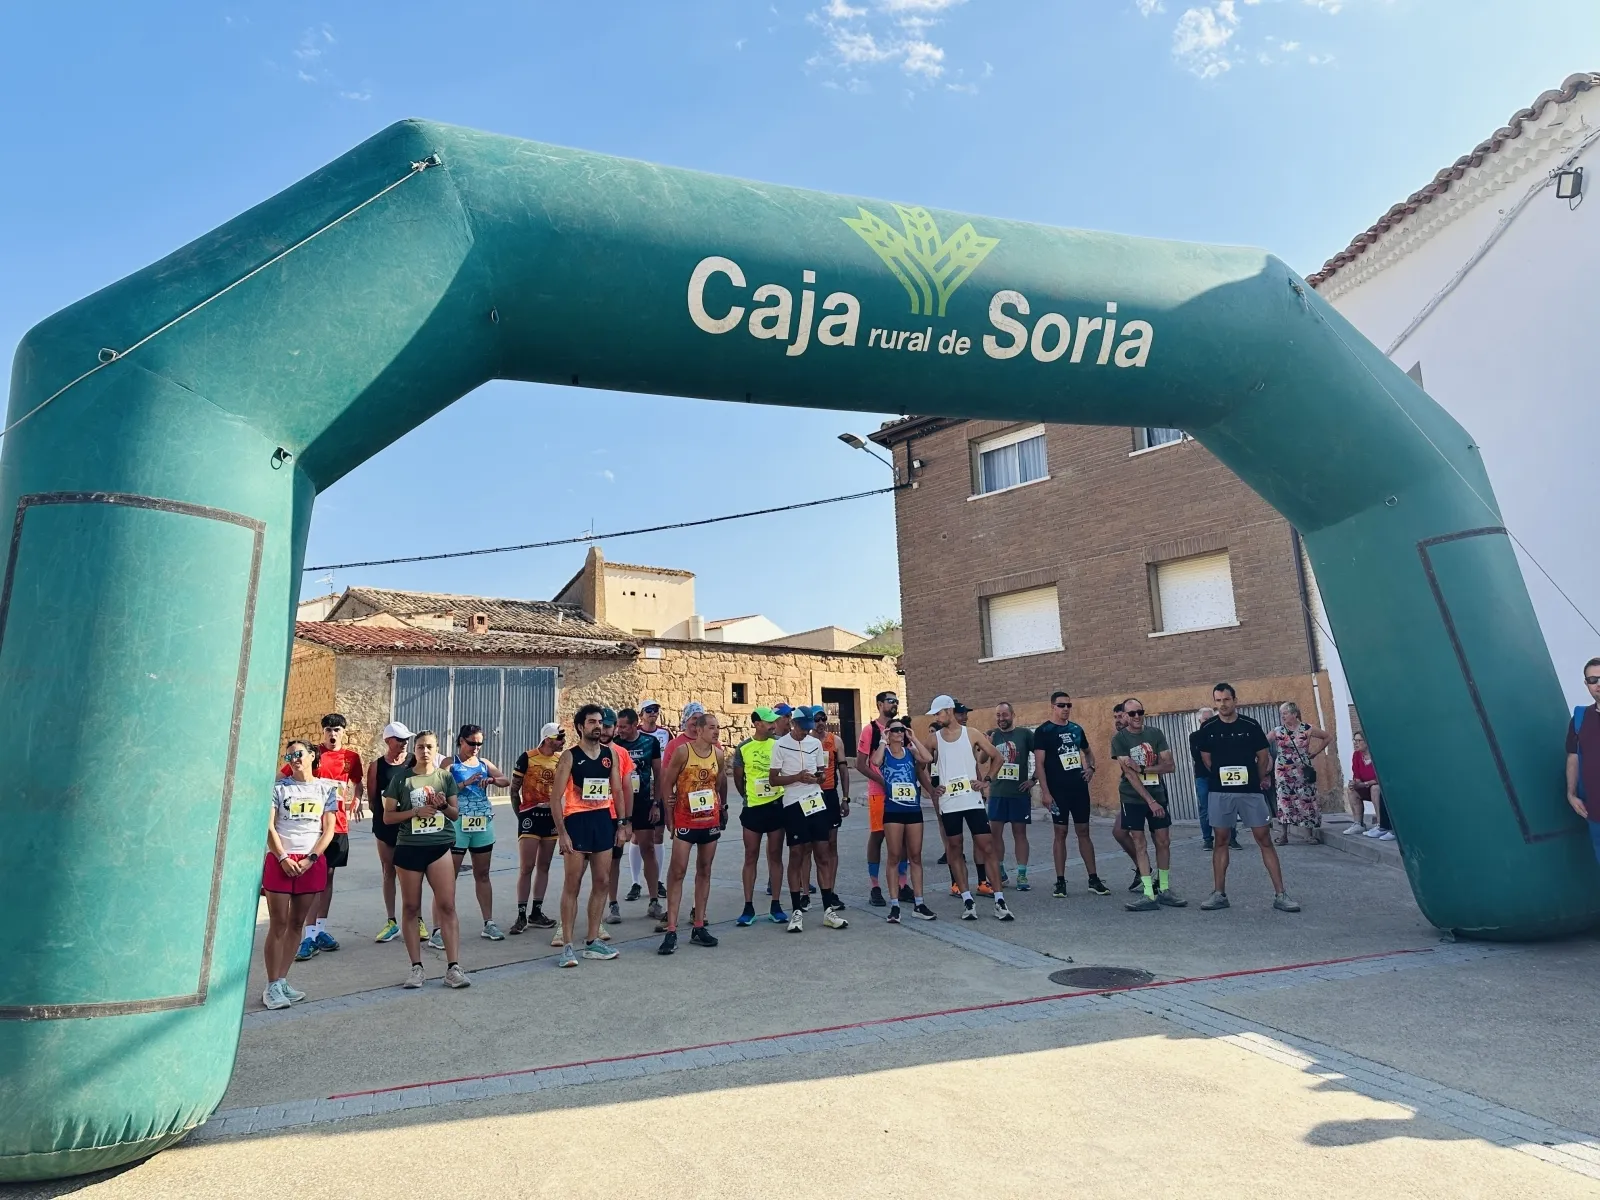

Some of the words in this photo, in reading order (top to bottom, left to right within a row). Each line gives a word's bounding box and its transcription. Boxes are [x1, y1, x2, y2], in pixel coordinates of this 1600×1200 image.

[687, 255, 860, 357] Caja
[868, 326, 932, 353] rural
[937, 330, 971, 356] de
[982, 290, 1154, 368] Soria
[1066, 756, 1079, 766] 23
[1002, 768, 1014, 777] 13
[1226, 771, 1241, 781] 25
[589, 784, 603, 795] 24
[763, 783, 771, 793] 8
[951, 781, 965, 792] 29
[897, 787, 911, 797] 33
[699, 796, 707, 806] 9
[809, 799, 818, 809] 2
[298, 802, 316, 813] 17
[419, 816, 437, 829] 32
[468, 817, 482, 827] 20
